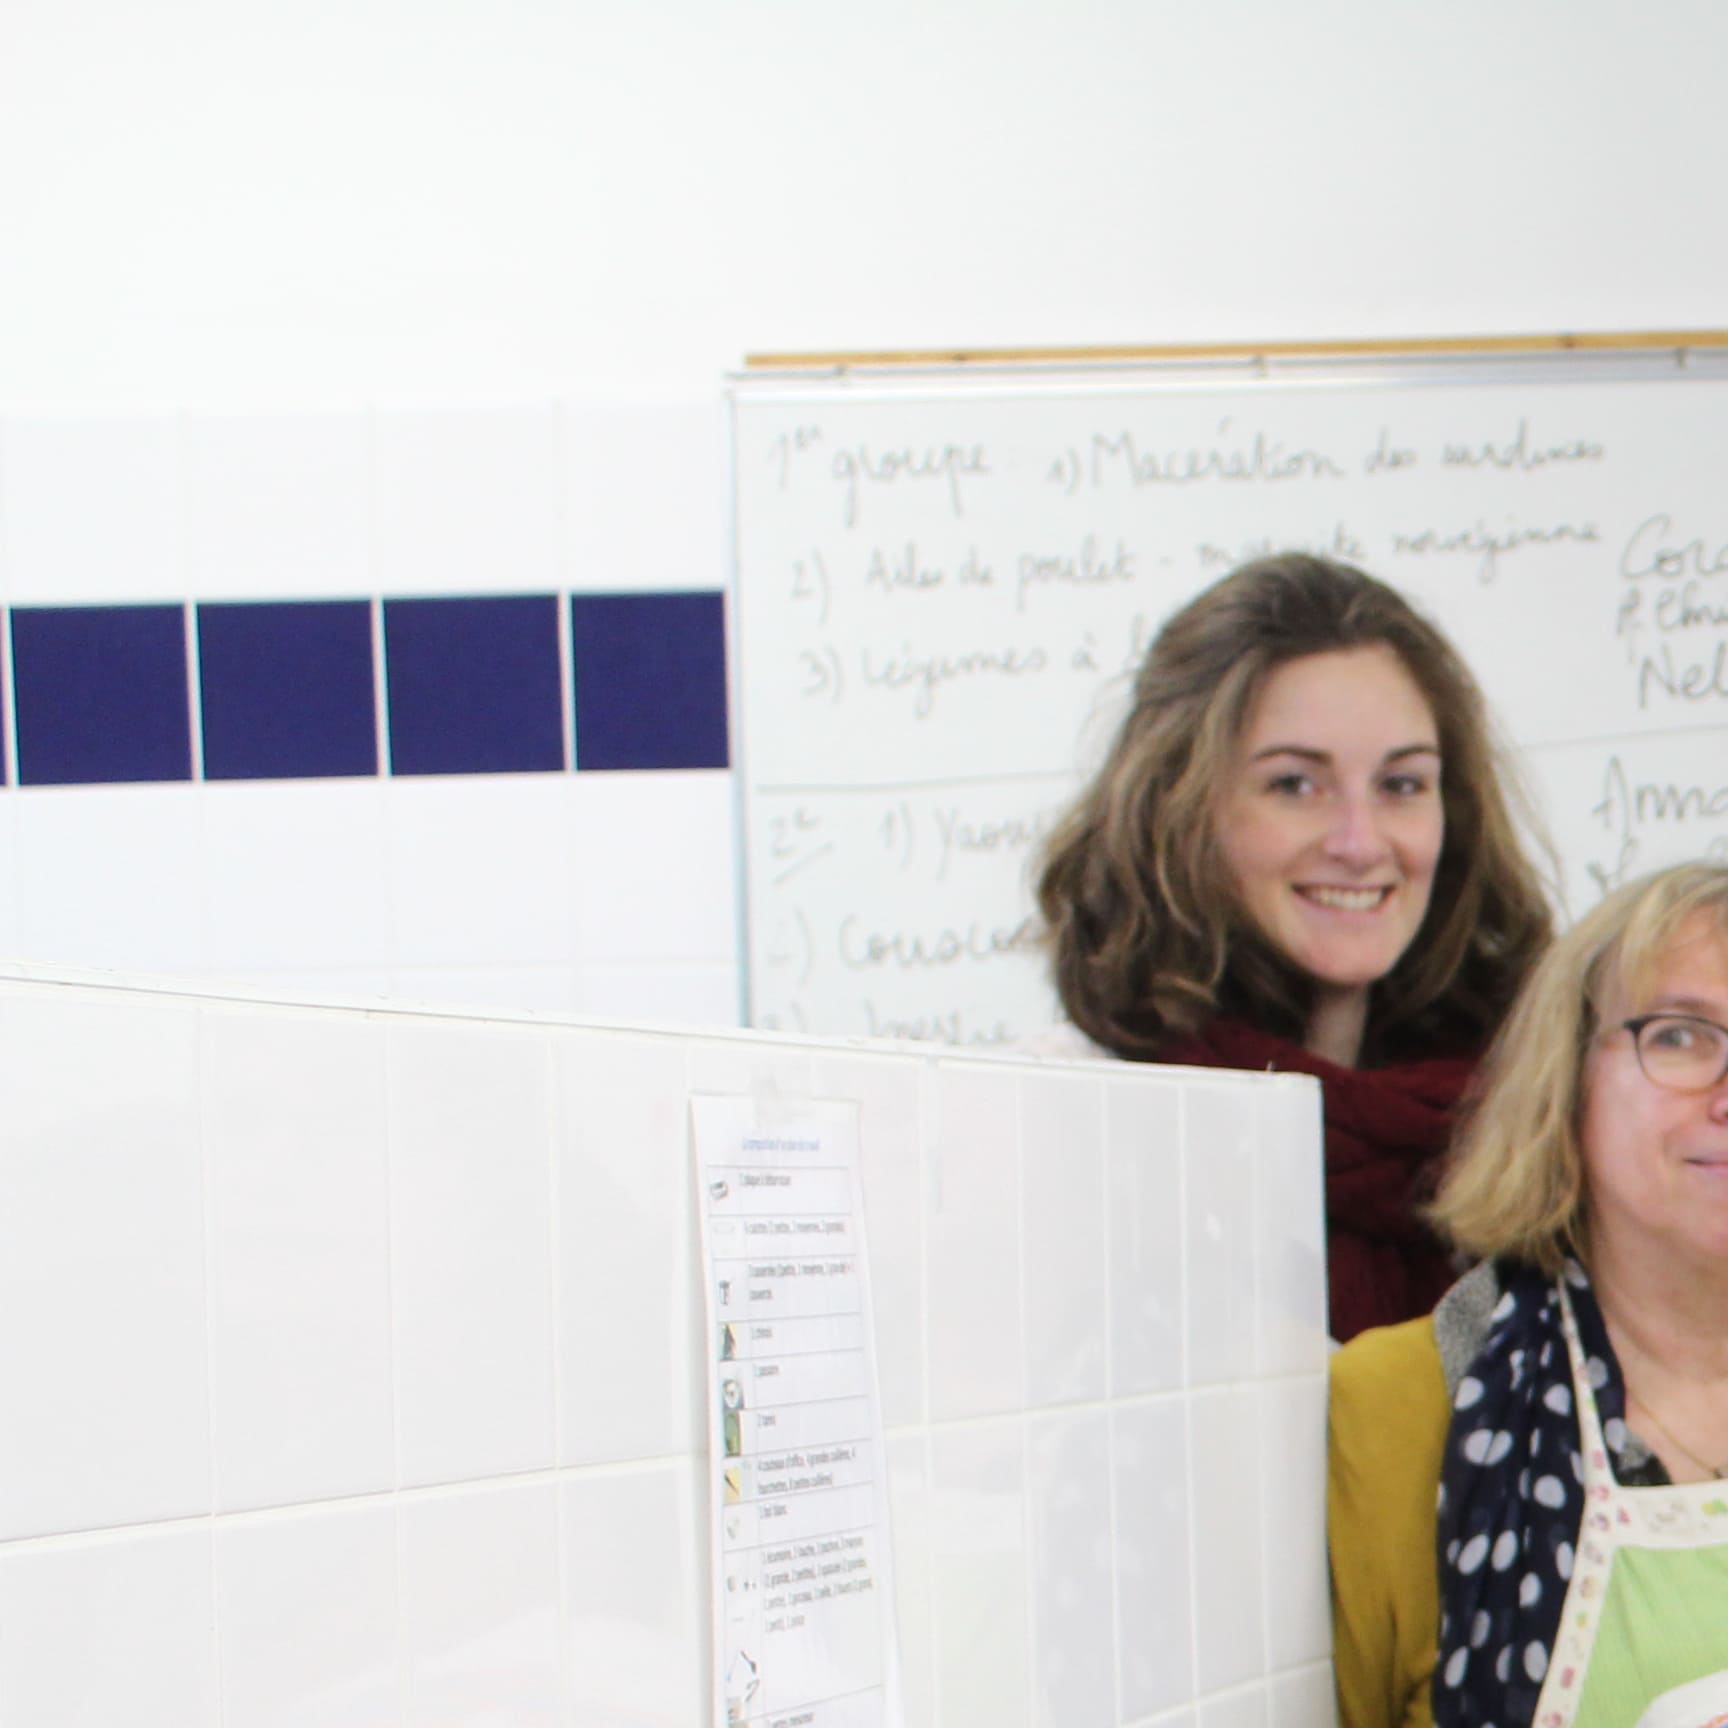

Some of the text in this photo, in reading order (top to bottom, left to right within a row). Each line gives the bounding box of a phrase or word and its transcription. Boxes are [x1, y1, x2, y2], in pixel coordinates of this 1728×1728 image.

[832, 443, 992, 530] groupe
[1363, 424, 1417, 477] des
[1440, 415, 1605, 473] sardines
[791, 546, 830, 628] 2)
[957, 547, 993, 589] de
[1017, 534, 1133, 613] poulet
[800, 645, 842, 705] 3)
[862, 638, 1049, 721] Légumes
